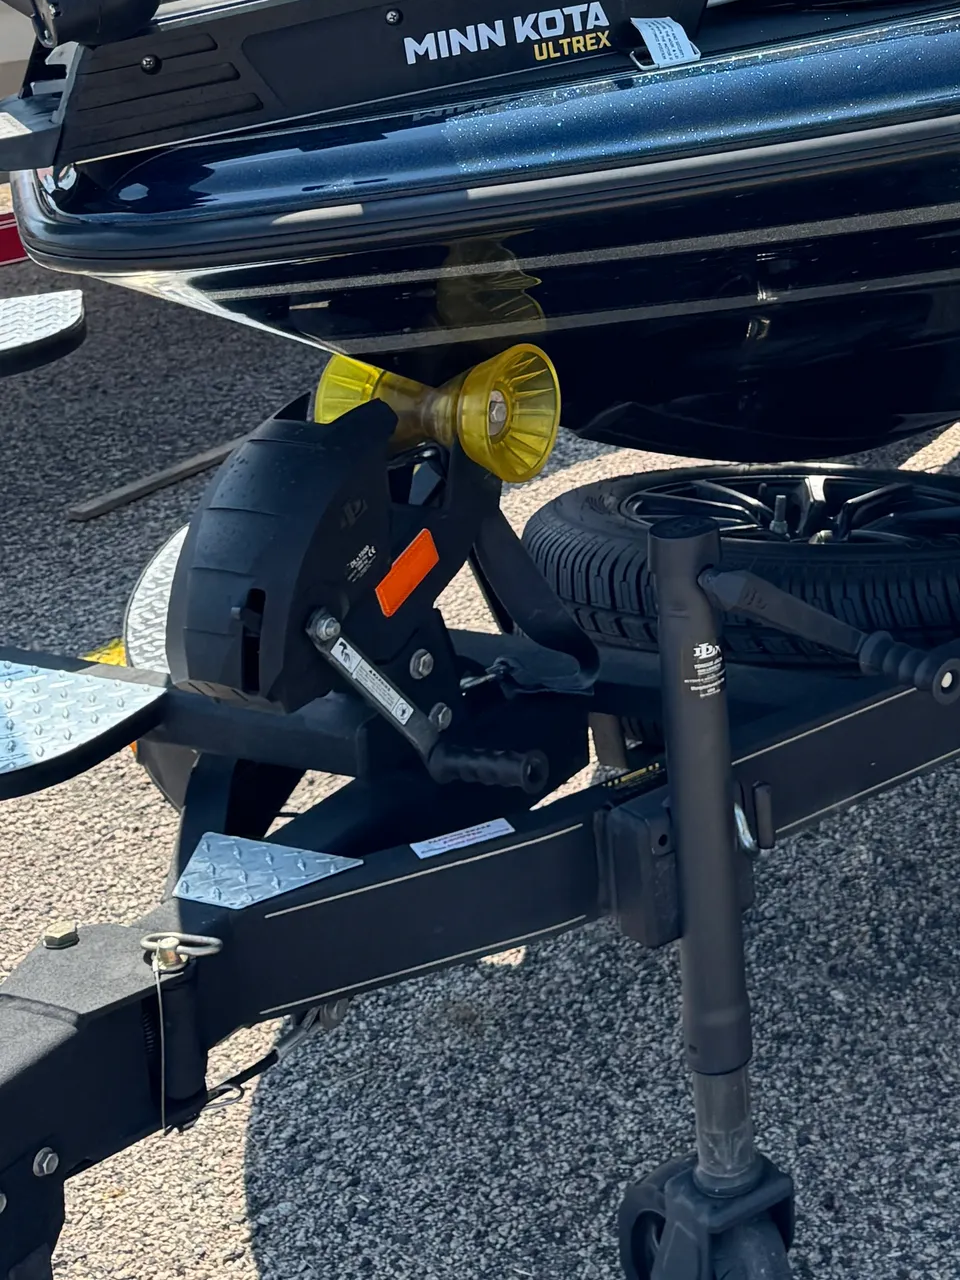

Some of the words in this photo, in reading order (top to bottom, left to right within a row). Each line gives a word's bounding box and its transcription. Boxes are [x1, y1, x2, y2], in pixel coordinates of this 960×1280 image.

[404, 19, 506, 65] MINN
[512, 1, 610, 44] KOTA
[533, 30, 612, 61] ULTREX
